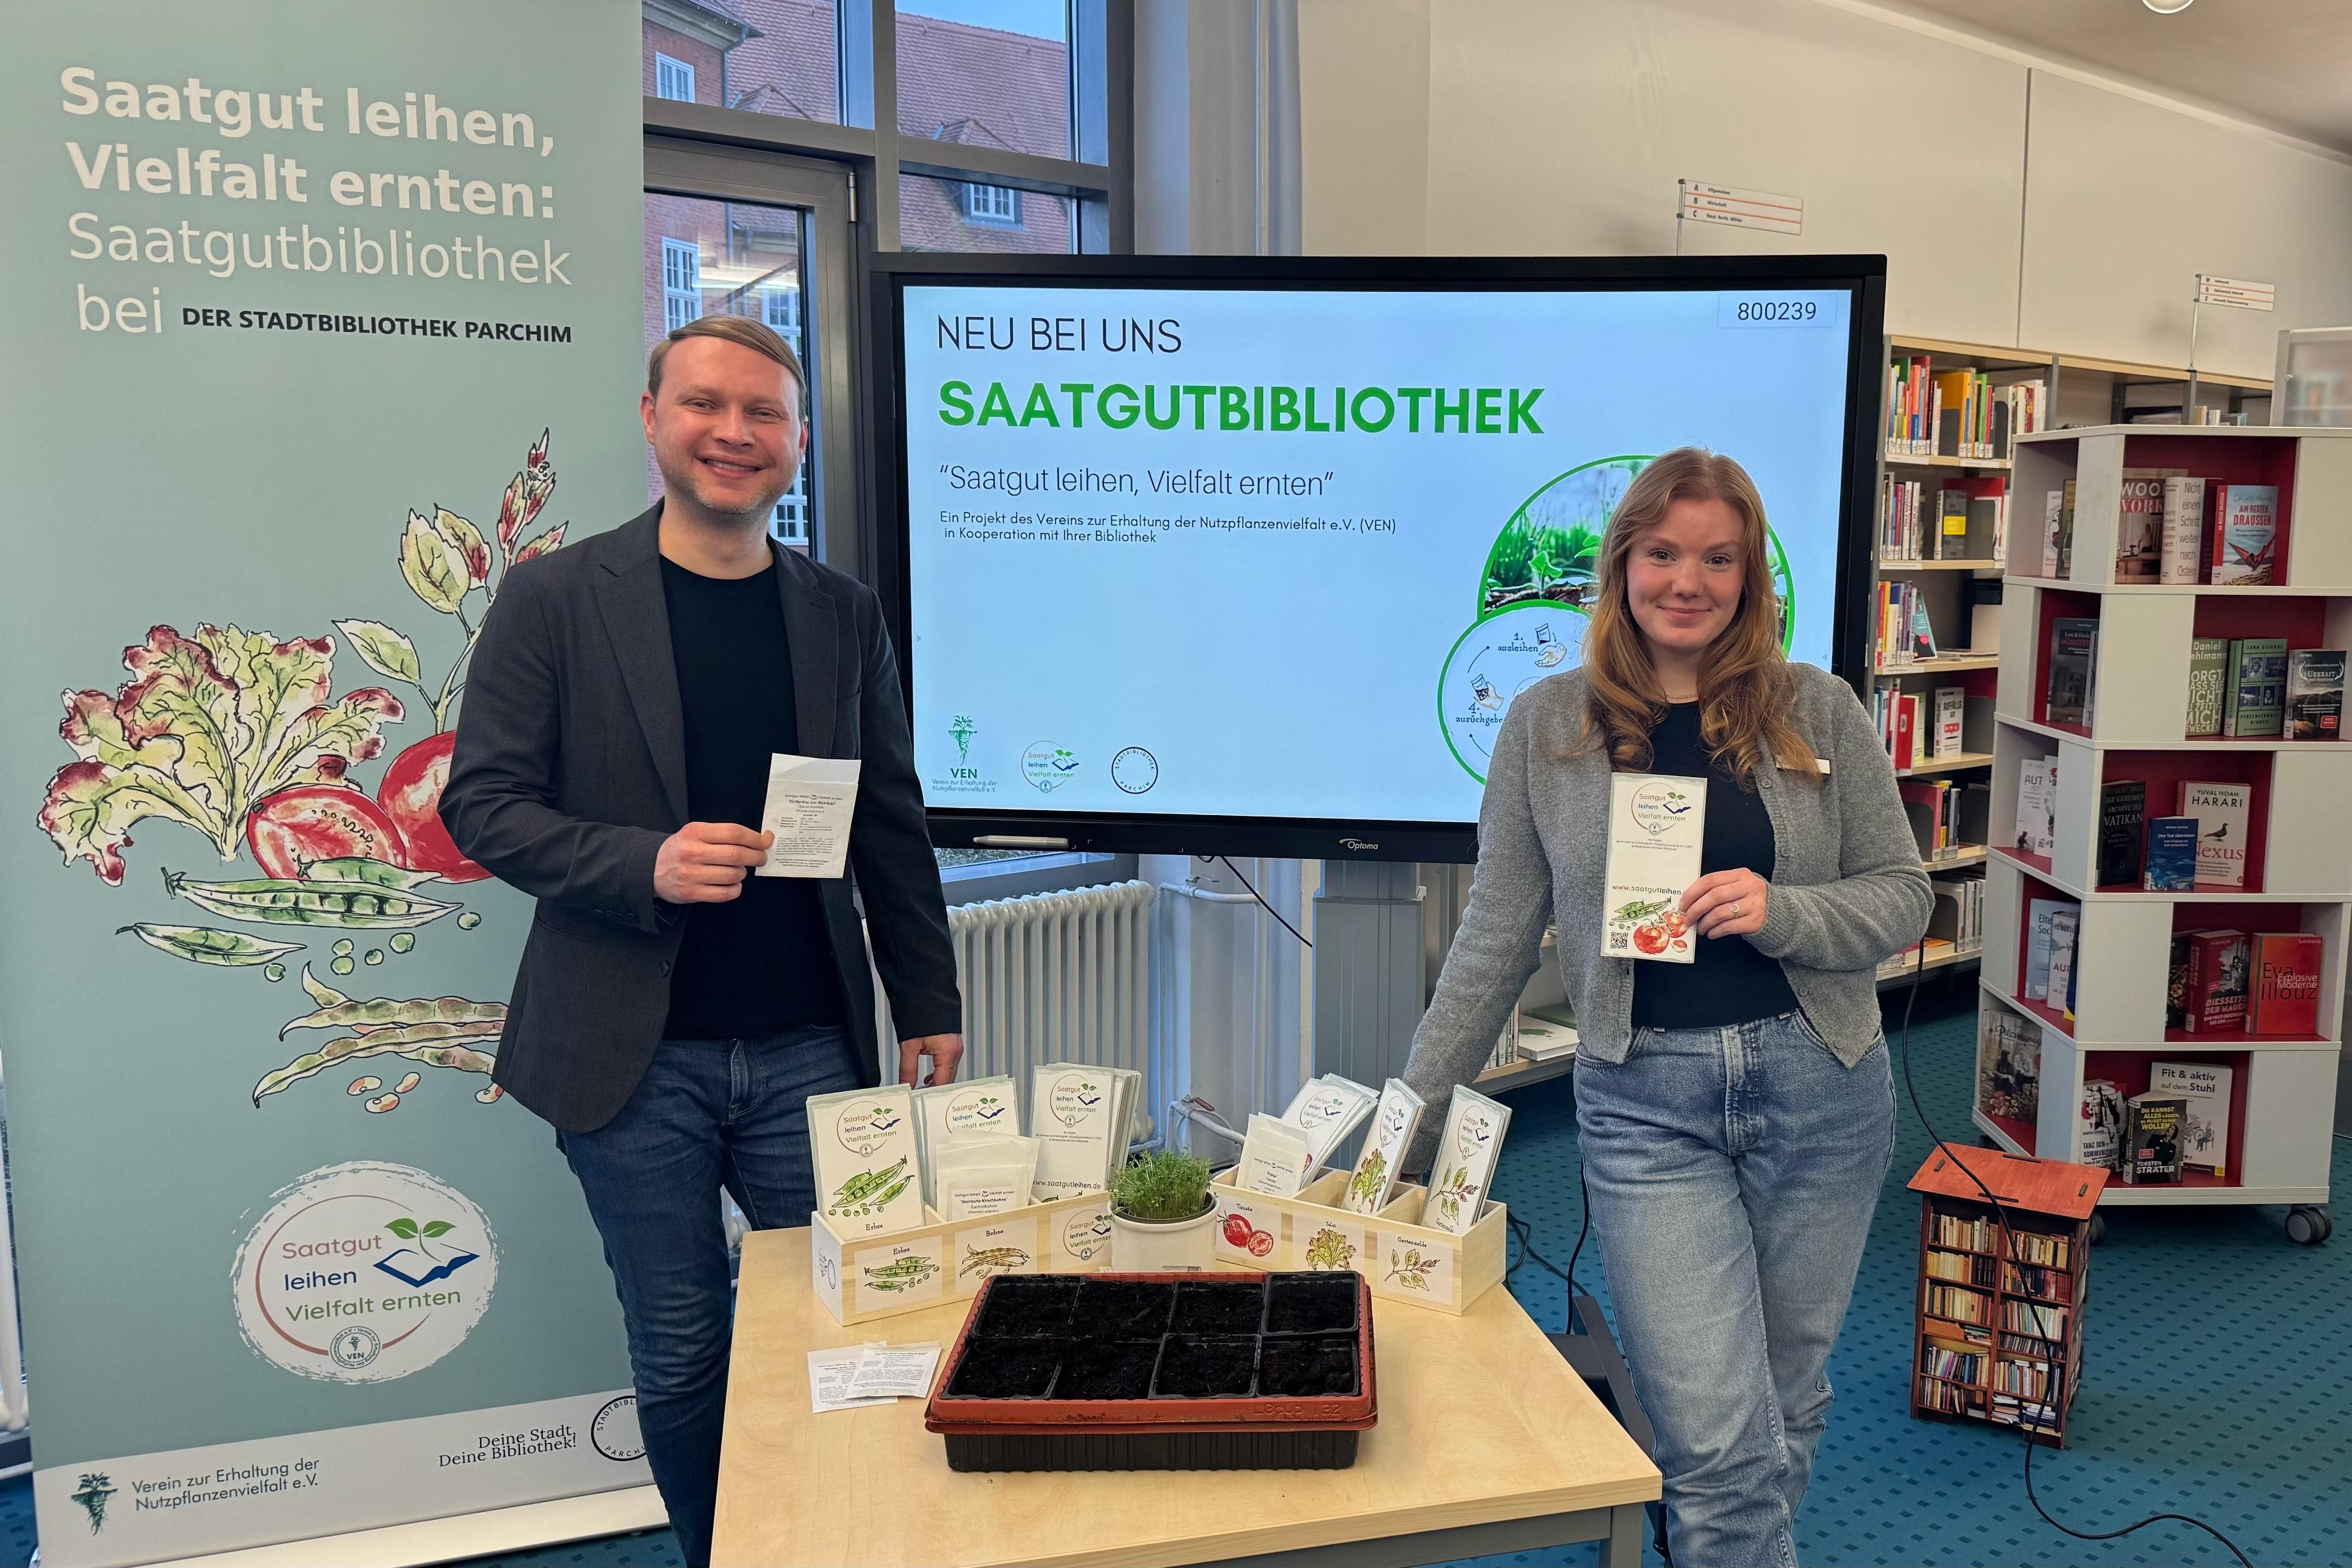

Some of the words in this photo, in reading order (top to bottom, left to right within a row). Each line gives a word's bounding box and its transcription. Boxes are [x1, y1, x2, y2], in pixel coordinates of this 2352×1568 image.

[60, 66, 324, 138] Saatgut
[346, 87, 555, 157] leihen,
[64, 142, 308, 203] Vielfalt
[329, 168, 555, 219] ernten:
[68, 212, 572, 286] Saatgutbibliothek
[77, 284, 162, 334] bei
[182, 308, 232, 328] DER
[238, 310, 458, 338] STADTBIBLIOTHEK
[464, 321, 572, 344] PARCHIM
[1737, 302, 1817, 321] 800239
[937, 314, 1014, 351] NEU
[1030, 317, 1086, 352] BEI
[1101, 318, 1182, 354] UNS
[938, 380, 1546, 435] SAATGUTBIBLIOTHEK
[1056, 467, 1138, 497] leihen,
[1147, 469, 1233, 495] Vielfalt
[2184, 482, 2201, 494] Nicht
[2121, 482, 2160, 497] WOO
[2182, 501, 2200, 510] einen
[2239, 505, 2249, 513] AM
[2249, 505, 2269, 513] BESTEN
[940, 511, 959, 523] Ein
[963, 511, 1006, 526] Projekt
[1010, 511, 1033, 524] des
[1036, 513, 1083, 526] Vereins
[1087, 517, 1106, 526] zur
[1110, 514, 1170, 530] Erhaltung
[1174, 515, 1196, 528] der
[1200, 516, 1326, 532] Nutzpflanzenvielfalt
[1330, 518, 1356, 531] e.V.
[1359, 518, 1396, 534] (VEN)
[2180, 516, 2200, 528] Schritt
[2233, 514, 2271, 526] DRAUSSEN
[945, 528, 955, 539] in
[959, 527, 1035, 542] Kooperation
[1039, 529, 1059, 541] mit
[1063, 529, 1092, 541] Ihrer
[1095, 530, 1156, 543] Bibliothek
[2179, 533, 2199, 543] weiter
[2179, 550, 2196, 560] nach
[2177, 565, 2196, 577] Osten
[1514, 632, 1523, 641] 1.
[1498, 641, 1538, 653] ausleihen
[2194, 640, 2221, 651] Daniel
[2190, 652, 2227, 660] ehlmann
[2191, 669, 2225, 682] ORGT,
[2189, 681, 2208, 691] ASS
[2191, 690, 2224, 703] ICHT
[1468, 702, 1480, 714] 4.
[1455, 713, 1504, 726] zurückgebe
[1114, 749, 1155, 770] STADTBIBLIOTHEK
[950, 768, 977, 779] VEN
[960, 779, 987, 787] Erhaltung
[1119, 780, 1150, 792] PARCHIM
[1639, 793, 1666, 801] Saatgut
[2191, 795, 2243, 808] HARARI
[1638, 812, 1661, 820] Vielfalt
[2104, 812, 2143, 827] VATIKAN
[1347, 841, 1379, 851] Optoma
[1612, 884, 1682, 896] www.saatgutleihen
[2038, 914, 2052, 924] Elte
[2038, 924, 2050, 935] Soc
[2263, 962, 2294, 979] Eva
[2277, 973, 2318, 982] Explosive
[2276, 981, 2318, 989] Moderne
[2261, 982, 2318, 1001] Illouz
[2205, 1006, 2221, 1015] DER
[2161, 1068, 2176, 1078] Fit
[2178, 1070, 2186, 1079] &
[2190, 1071, 2216, 1081] aktiv
[1057, 1086, 1080, 1094] Saatgut
[2189, 1082, 2215, 1093] Stuhl
[952, 1103, 979, 1112] Saatgut
[843, 1113, 873, 1123] Saatgut
[979, 1119, 1001, 1128] ernten
[844, 1125, 866, 1134] leihen
[845, 1134, 871, 1143] Vielfalt
[873, 1130, 897, 1139] ernten
[2136, 1165, 2175, 1174] STRÄTER
[1069, 1221, 1094, 1230] Saatgut
[1070, 1231, 1088, 1239] leihen
[282, 1234, 383, 1259] Saatgut
[1070, 1239, 1092, 1248] Vielfalt
[285, 1270, 357, 1291] leihen
[285, 1297, 374, 1322] Vielfalt
[382, 1290, 461, 1311] ernten
[346, 1352, 364, 1360] VEN
[597, 1399, 637, 1431] STADTBIBL
[478, 1434, 525, 1449] Deine
[530, 1424, 577, 1442] Stadt,
[439, 1451, 487, 1467] Deine
[492, 1435, 577, 1460] Bibliothek!
[605, 1445, 647, 1457] PARCHI
[132, 1477, 181, 1494] Verein
[187, 1474, 211, 1487] zur
[216, 1464, 289, 1483] Erhaltung
[295, 1457, 320, 1472] der
[136, 1477, 287, 1511] Nutzpflanzenvielfalt
[292, 1473, 318, 1489] e.V.
